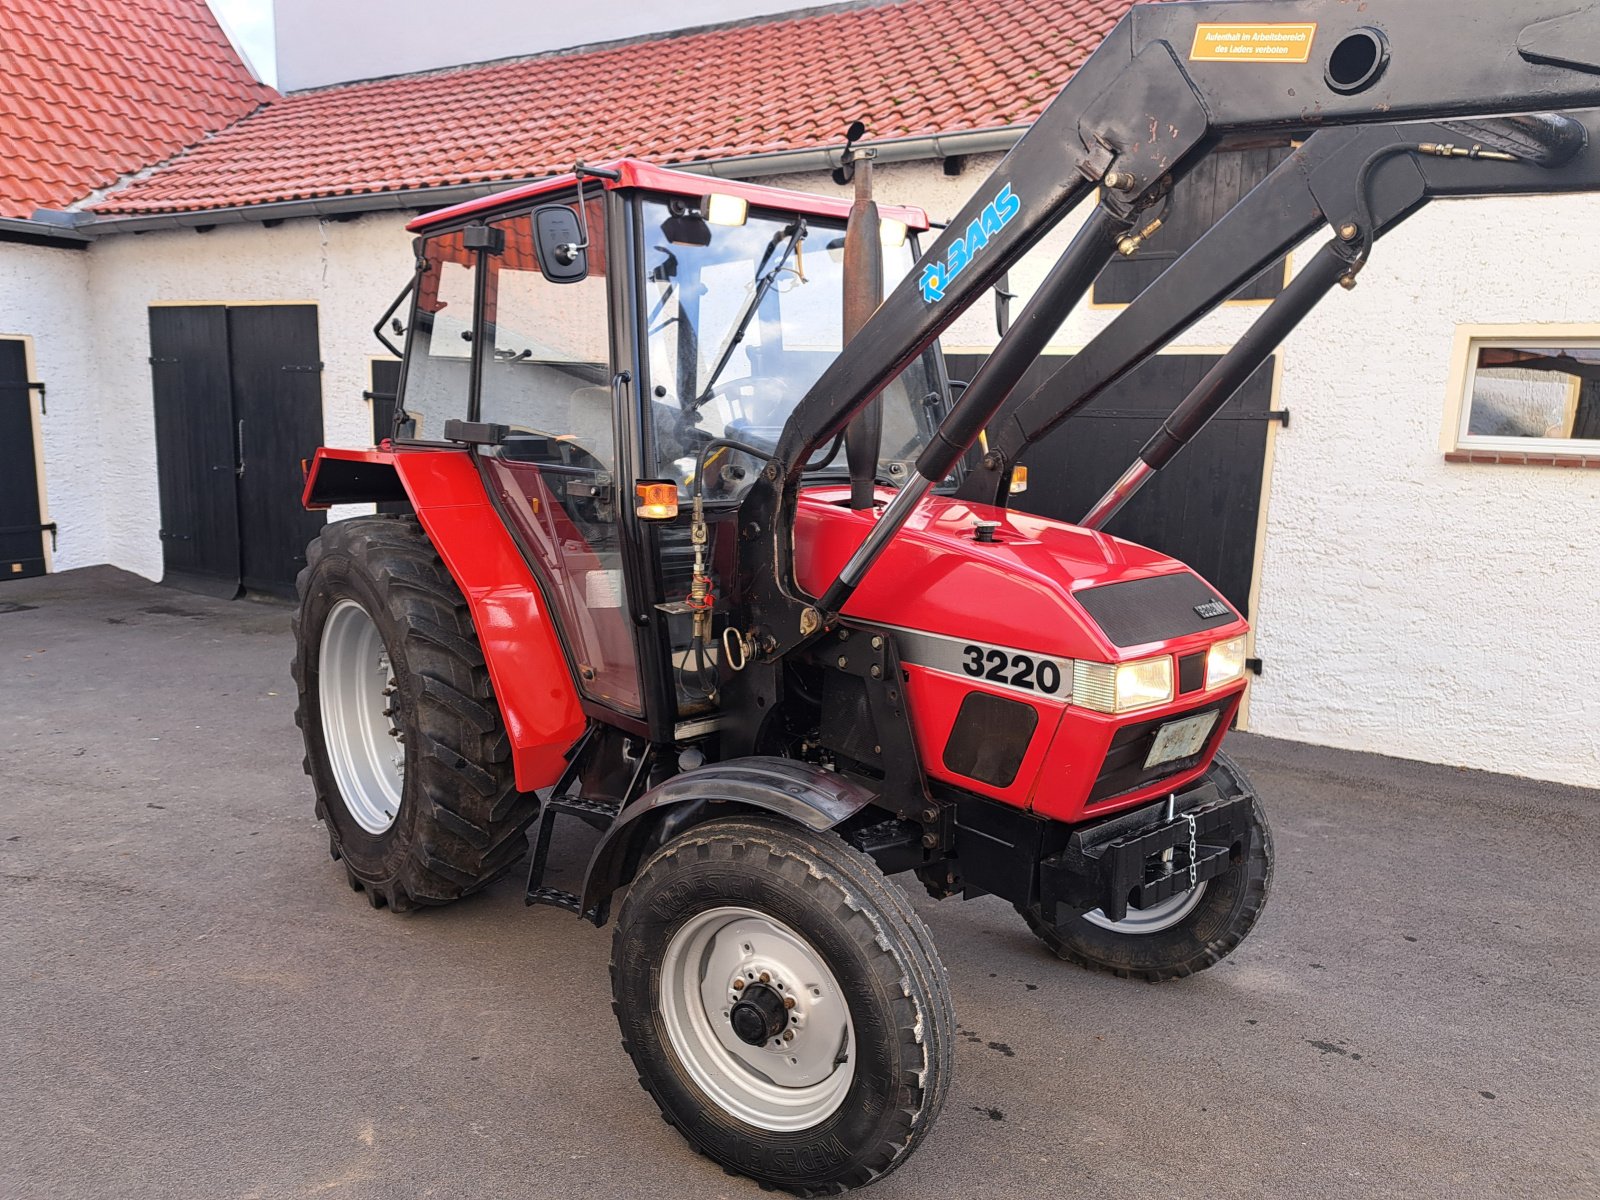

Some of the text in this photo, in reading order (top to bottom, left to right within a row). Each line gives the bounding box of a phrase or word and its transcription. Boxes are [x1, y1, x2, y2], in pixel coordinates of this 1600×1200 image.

[1205, 32, 1306, 41] Aufenthalt im Arbeitsbereich
[1215, 44, 1288, 54] des Laders verboten
[948, 182, 1021, 281] BAAS
[962, 645, 1061, 694] 3220
